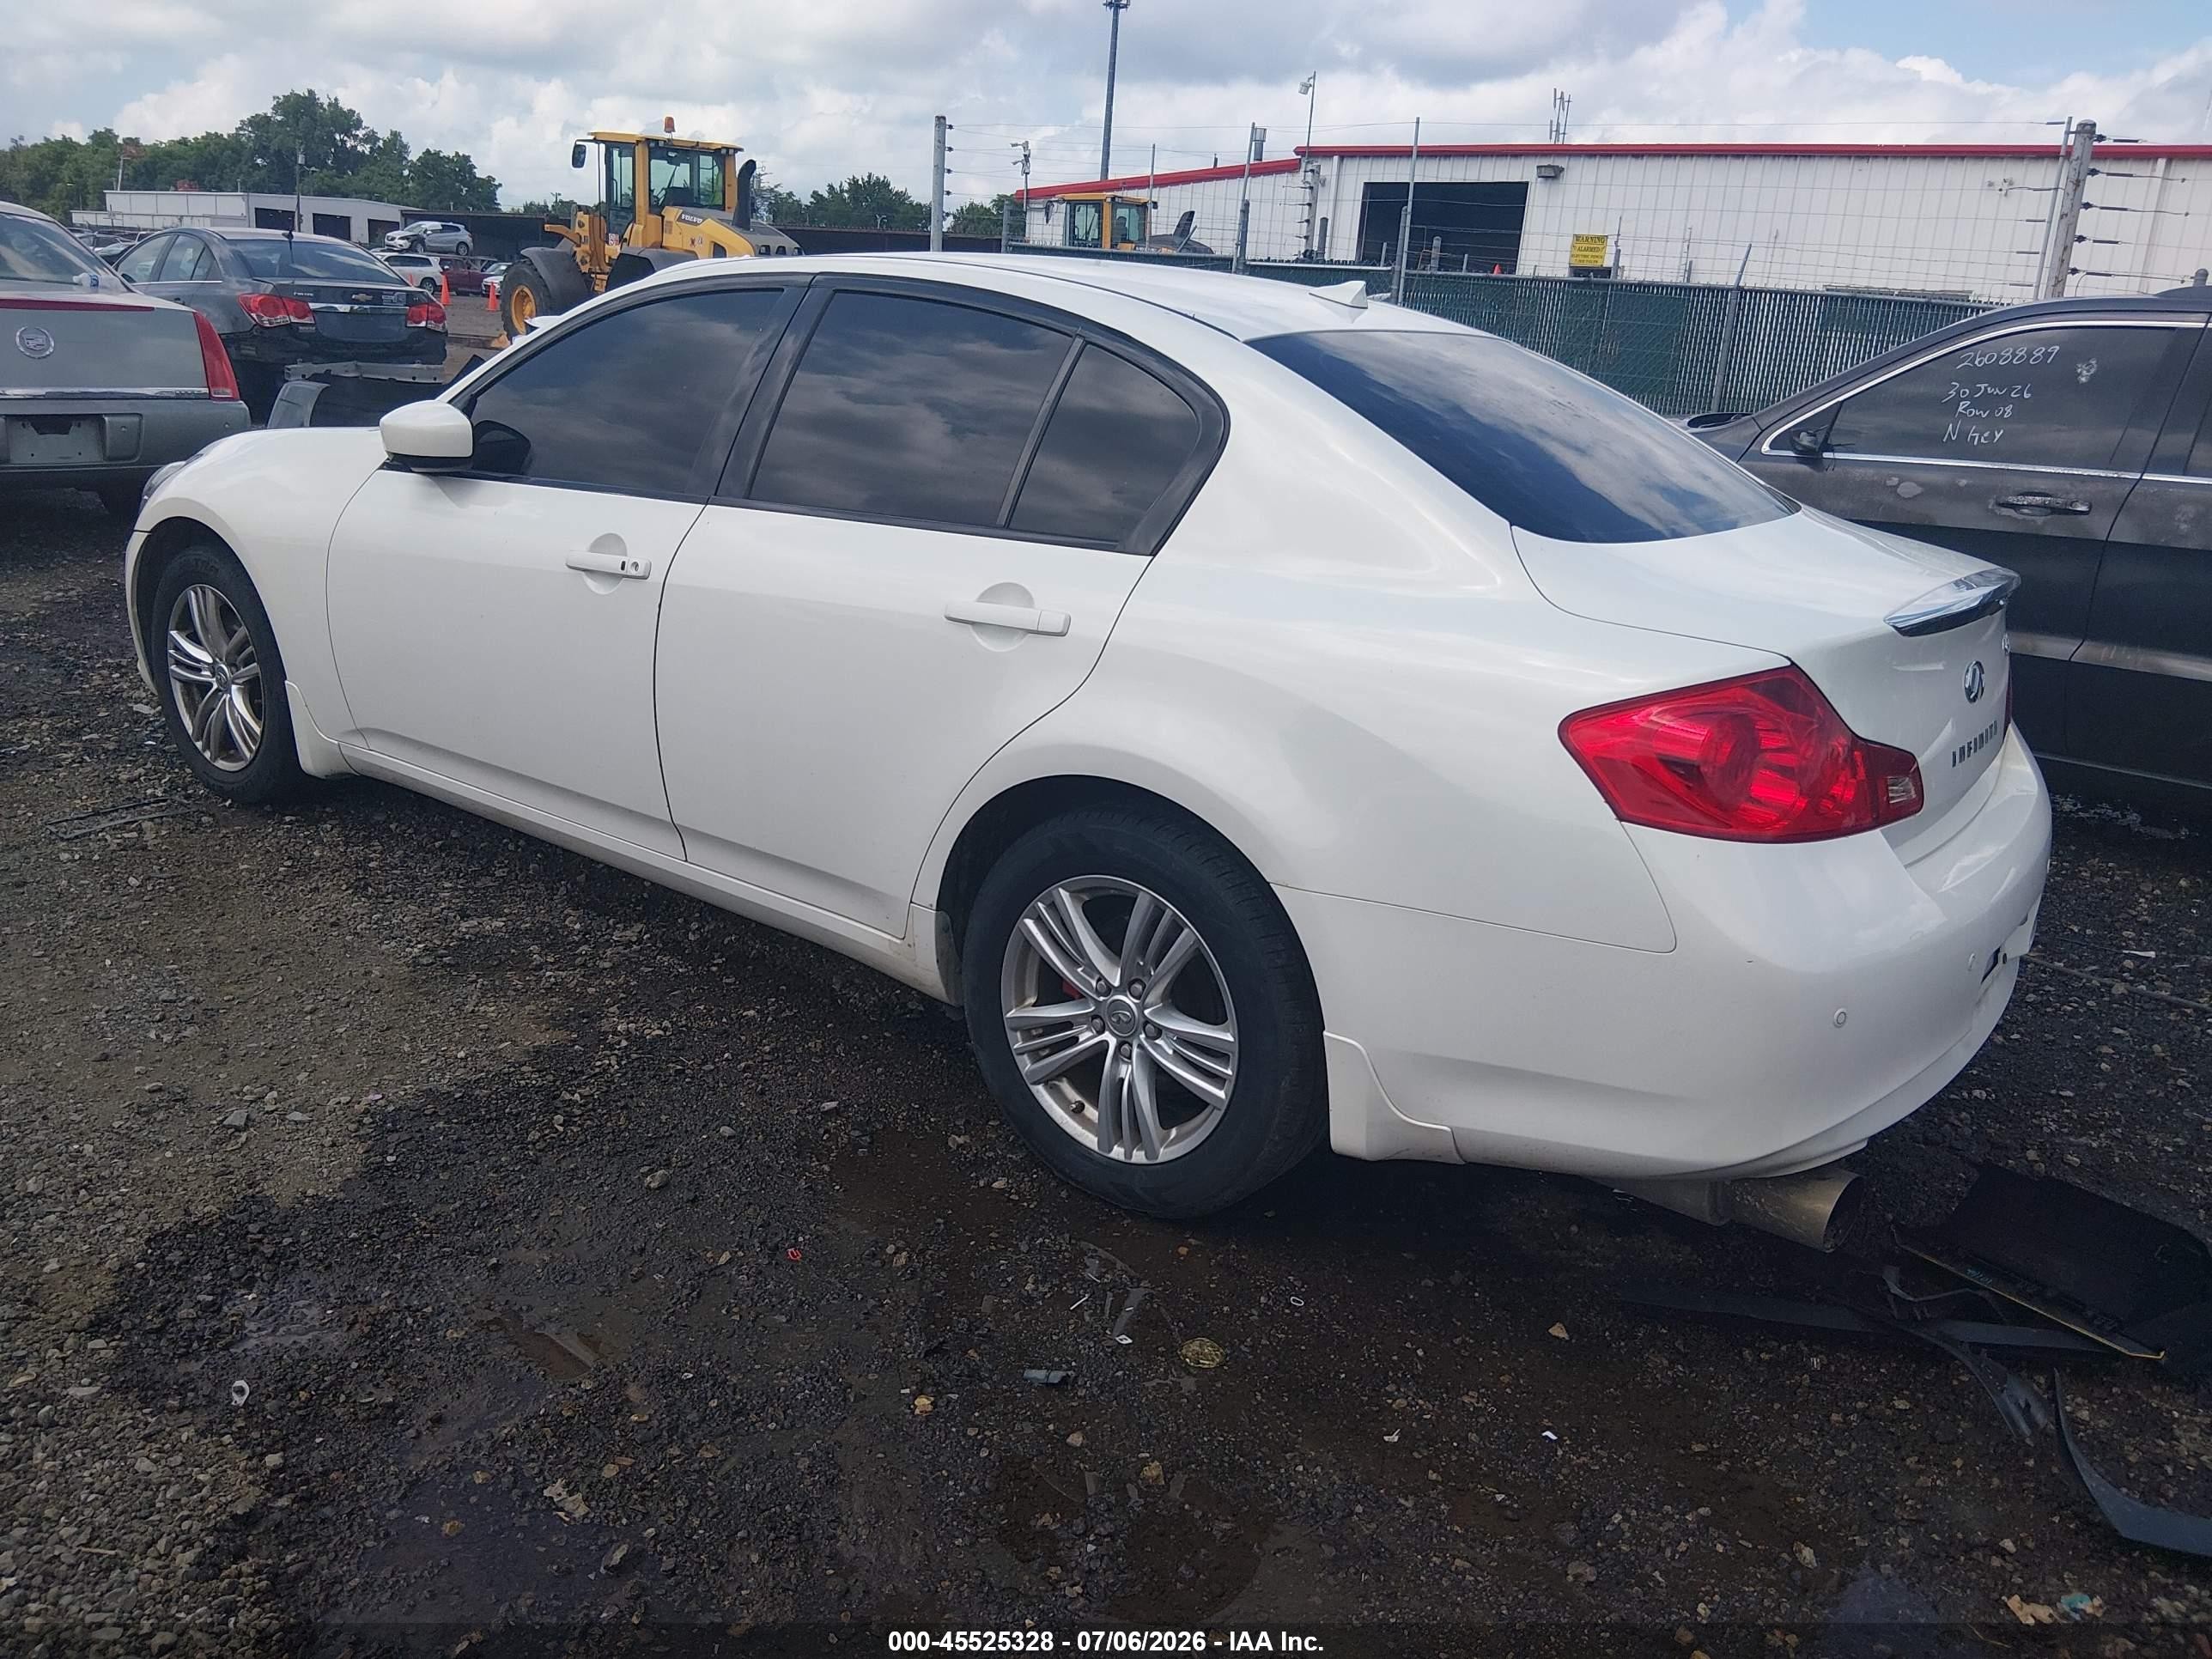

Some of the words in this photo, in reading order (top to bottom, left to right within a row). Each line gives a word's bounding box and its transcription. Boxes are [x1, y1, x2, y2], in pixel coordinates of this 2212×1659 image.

[1956, 345, 2060, 369] 2608889
[1941, 381, 1970, 403] 30
[2010, 383, 2033, 398] 26
[1994, 404, 2014, 418] 08
[1952, 720, 1998, 769] INFINITI
